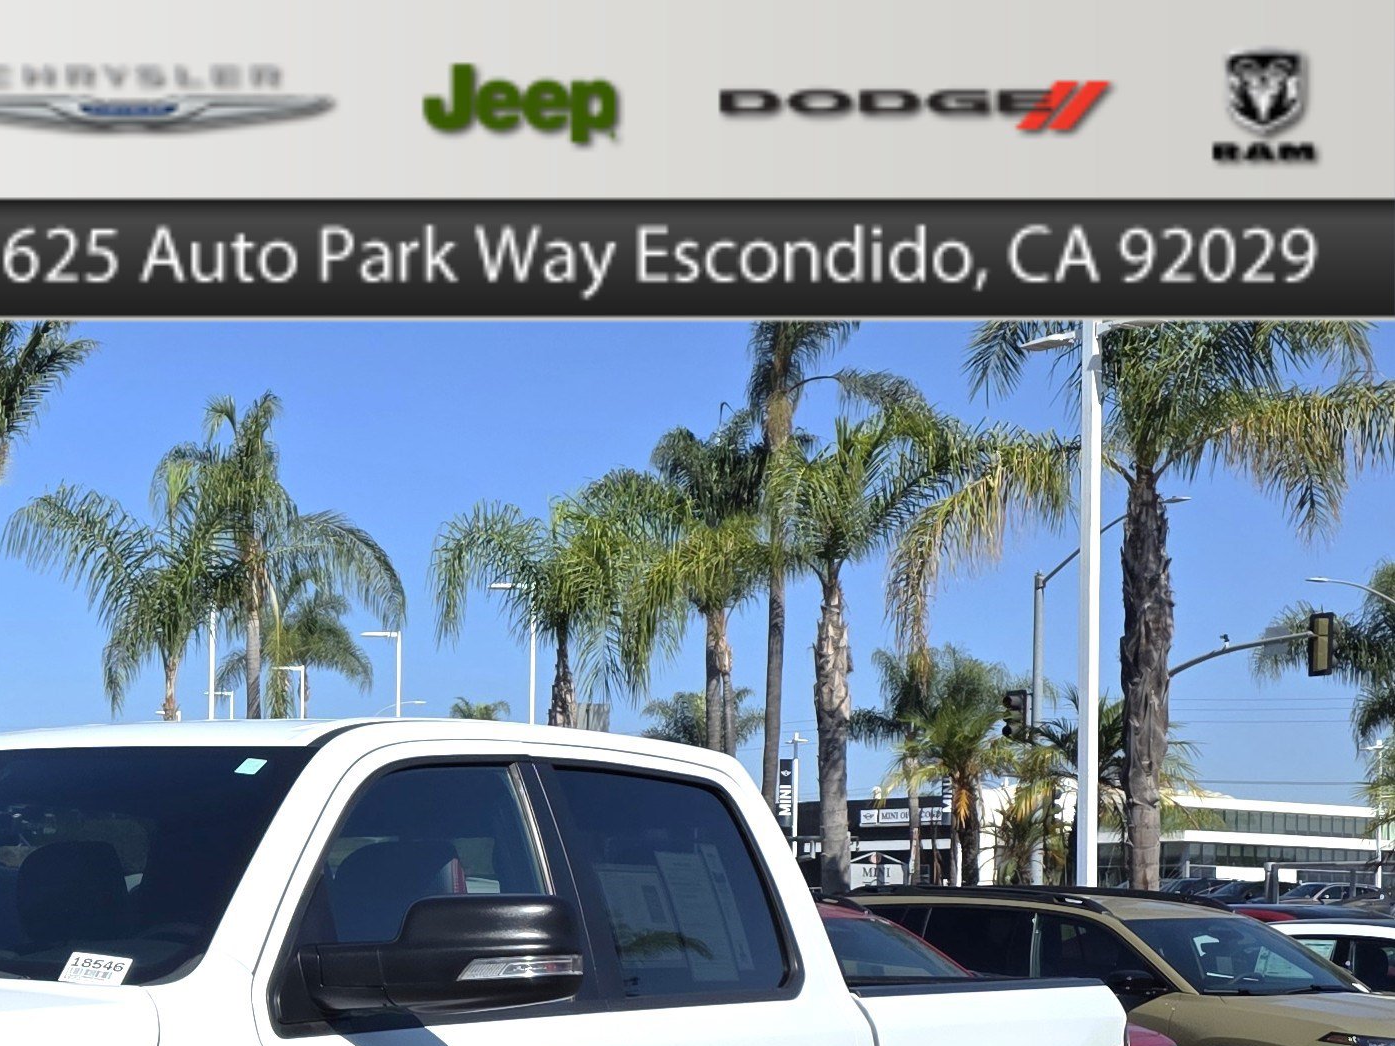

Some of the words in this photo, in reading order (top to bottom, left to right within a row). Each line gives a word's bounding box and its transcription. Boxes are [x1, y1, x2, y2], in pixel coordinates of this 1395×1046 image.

[779, 785, 791, 815] MINI
[862, 867, 891, 877] MINI
[71, 957, 125, 972] 18546
